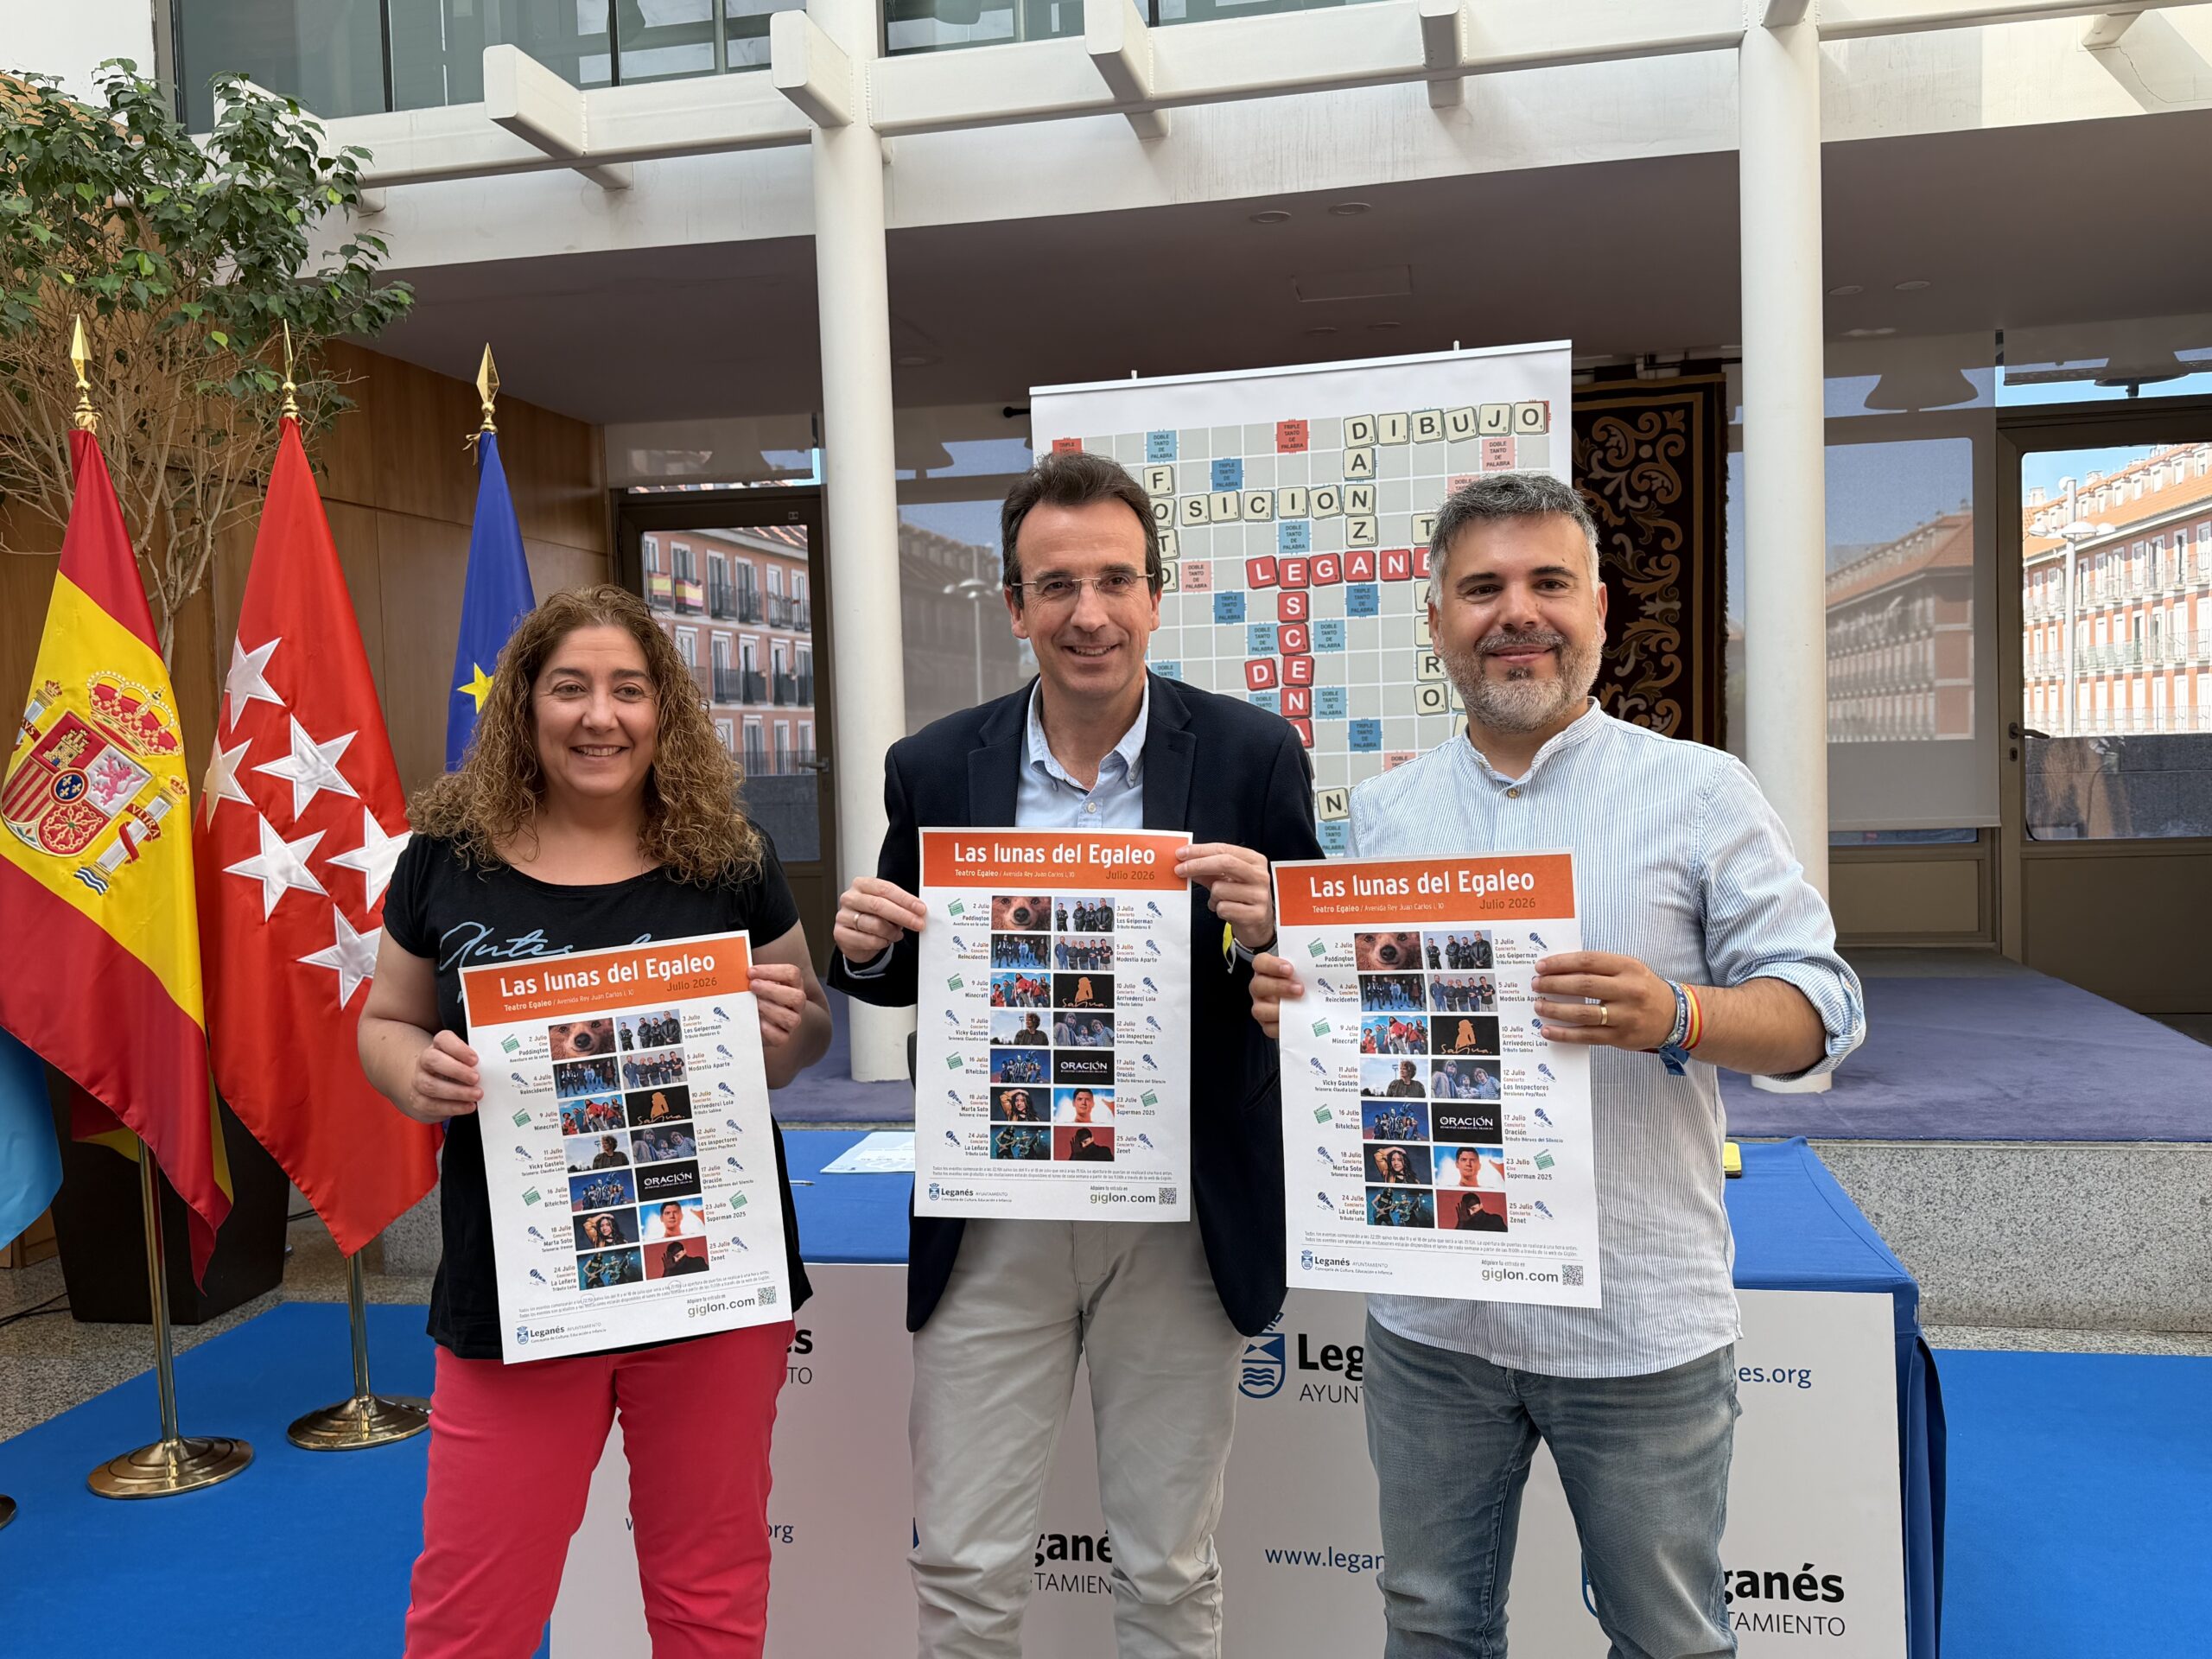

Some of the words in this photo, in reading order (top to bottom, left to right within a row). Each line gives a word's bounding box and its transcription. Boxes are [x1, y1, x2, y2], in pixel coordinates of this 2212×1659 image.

[1351, 407, 1541, 442] DIBUJO
[131, 804, 159, 838] VLTRA
[954, 842, 987, 863] Las
[995, 842, 1046, 863] lunas
[1052, 843, 1082, 863] del
[1089, 843, 1155, 868] Egaleo
[977, 869, 998, 878] Egaleo
[1105, 870, 1128, 880] Julio
[1131, 870, 1155, 880] 2026
[1310, 876, 1346, 898] Las
[1352, 874, 1410, 896] lunas
[1417, 871, 1450, 894] del
[1458, 868, 1535, 897] Egaleo
[1313, 905, 1335, 913] Teatro
[1336, 904, 1360, 913] Egaleo
[1364, 904, 1386, 912] Avenida
[1479, 899, 1505, 910] Julio
[1508, 898, 1536, 909] 2026
[499, 977, 537, 997] Las
[543, 969, 601, 992] lunas
[607, 960, 639, 983] del
[645, 954, 715, 982] Egaleo
[666, 981, 690, 992] Julio
[692, 976, 717, 989] 2026
[504, 1003, 527, 1012] Teatro
[528, 999, 552, 1010] Egaleo
[1060, 1061, 1108, 1071] ORACIÓN
[1440, 1116, 1493, 1127] ORACIÓN
[644, 1172, 692, 1186] ORACIÓN
[941, 1187, 974, 1198] Leganés
[1090, 1192, 1156, 1204] giglon.com
[1314, 1255, 1351, 1267] Leganés
[1481, 1268, 1559, 1283] giglon.com
[687, 1296, 755, 1319] giglon.com
[530, 1325, 565, 1338] Leganés
[1299, 1382, 1363, 1404] AYUN
